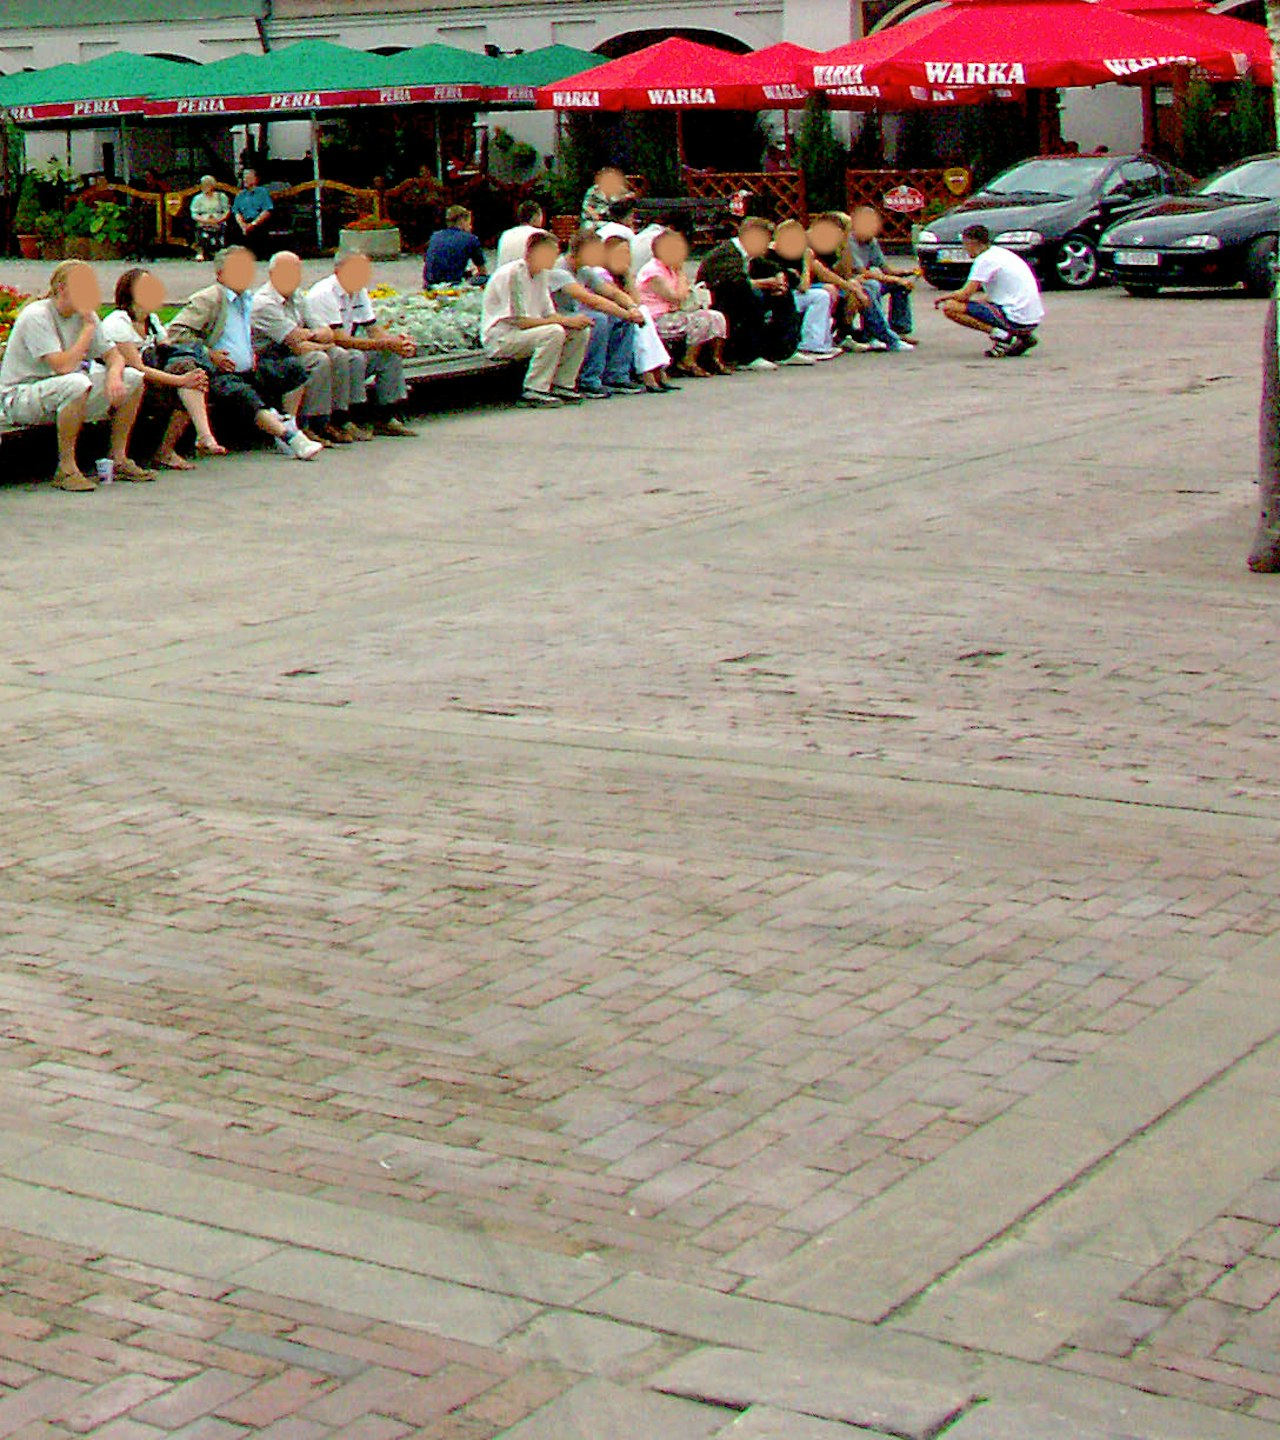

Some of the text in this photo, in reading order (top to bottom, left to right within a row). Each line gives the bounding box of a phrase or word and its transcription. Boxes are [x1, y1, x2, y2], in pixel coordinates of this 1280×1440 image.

[924, 62, 1025, 85] WARKA
[552, 91, 599, 107] WARKA
[648, 89, 715, 104] WARKA
